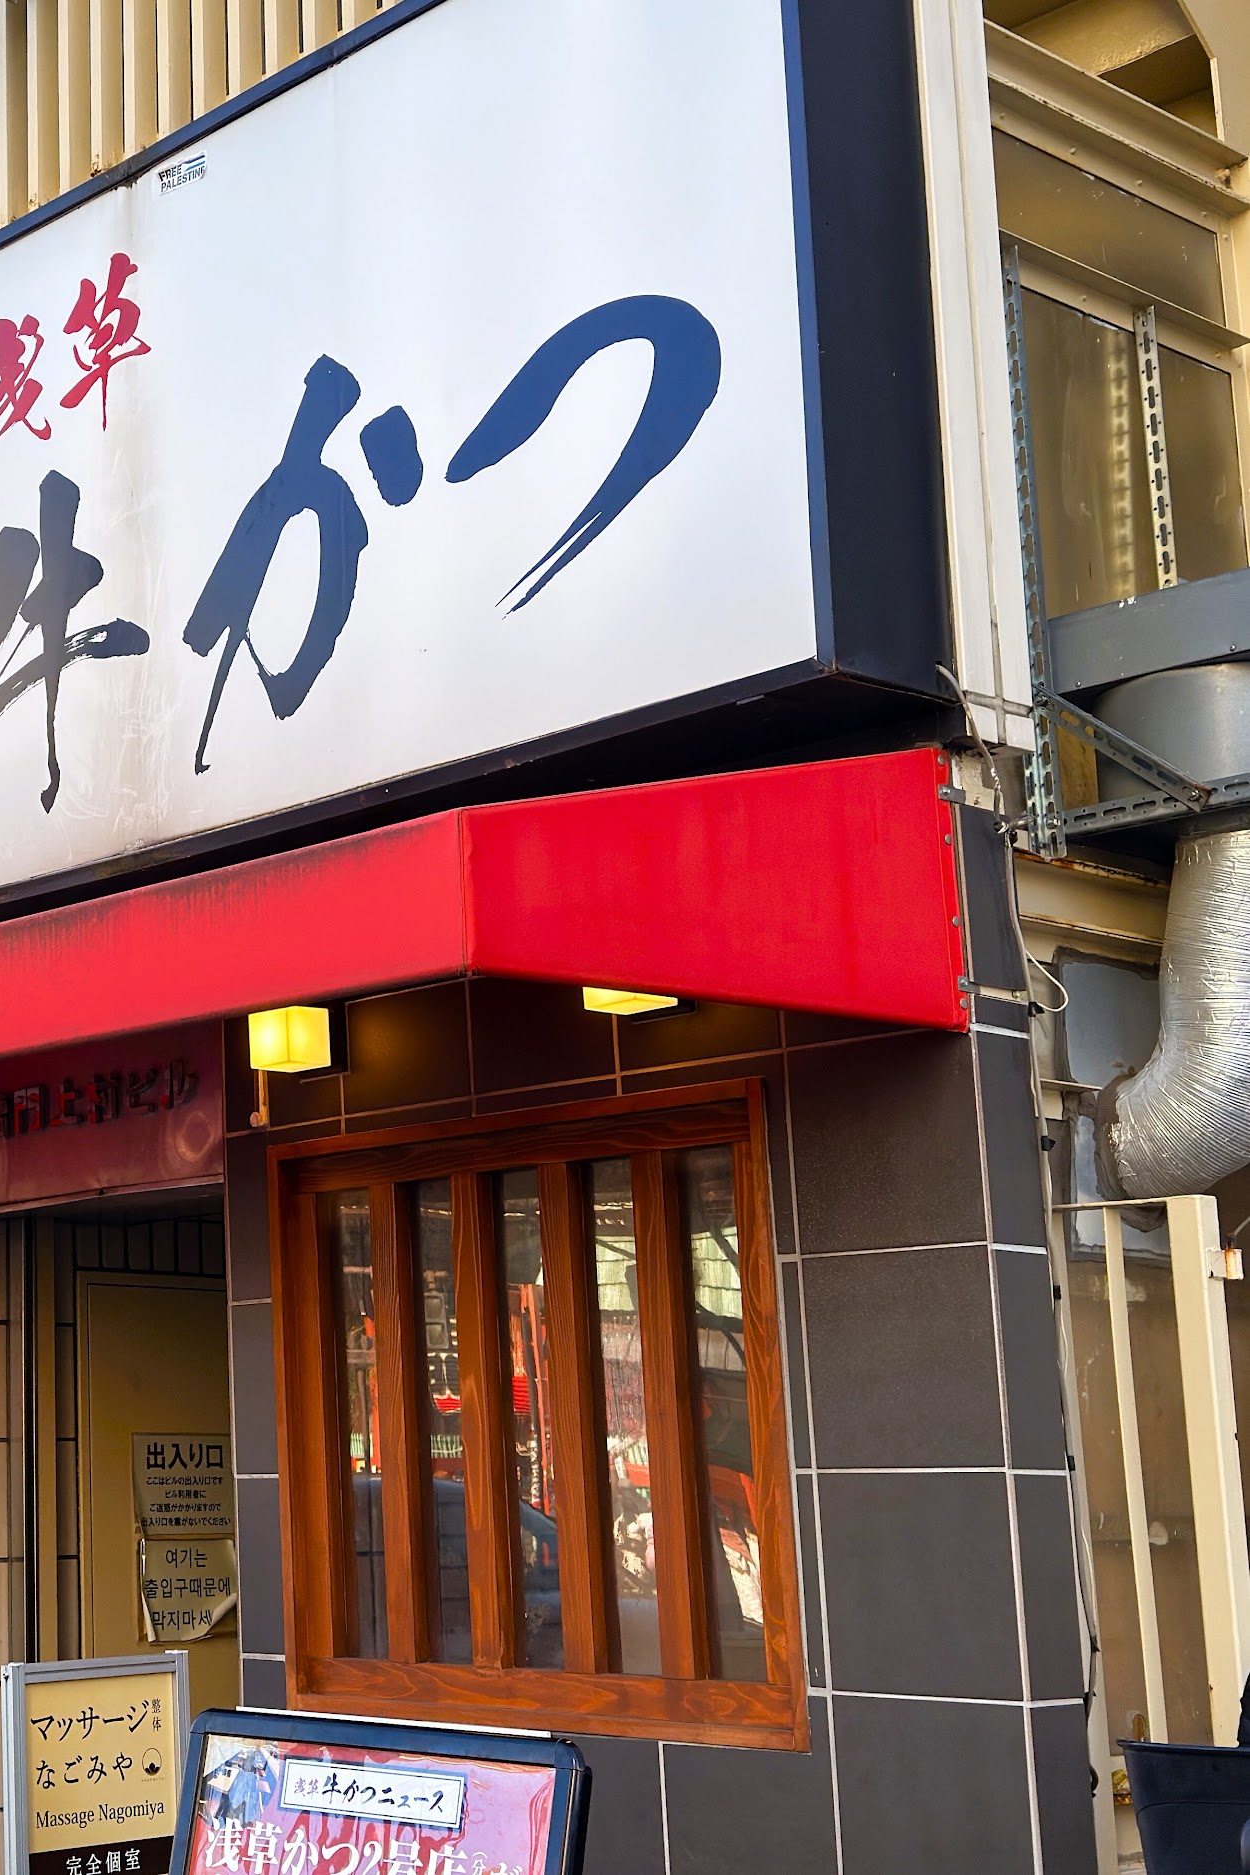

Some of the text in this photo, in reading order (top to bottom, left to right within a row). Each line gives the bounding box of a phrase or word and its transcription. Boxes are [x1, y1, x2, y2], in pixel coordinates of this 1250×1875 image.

[158, 164, 182, 182] FREE
[146, 1442, 223, 1470] 出入り口
[146, 1476, 223, 1485] ここはビルの出入り口です
[165, 1548, 207, 1568] 여기는
[30, 1699, 149, 1741] マッサージ
[35, 1752, 133, 1789] なごみや
[36, 1799, 165, 1829] Massage Nagomiya
[66, 1848, 141, 1875] 完全個室
